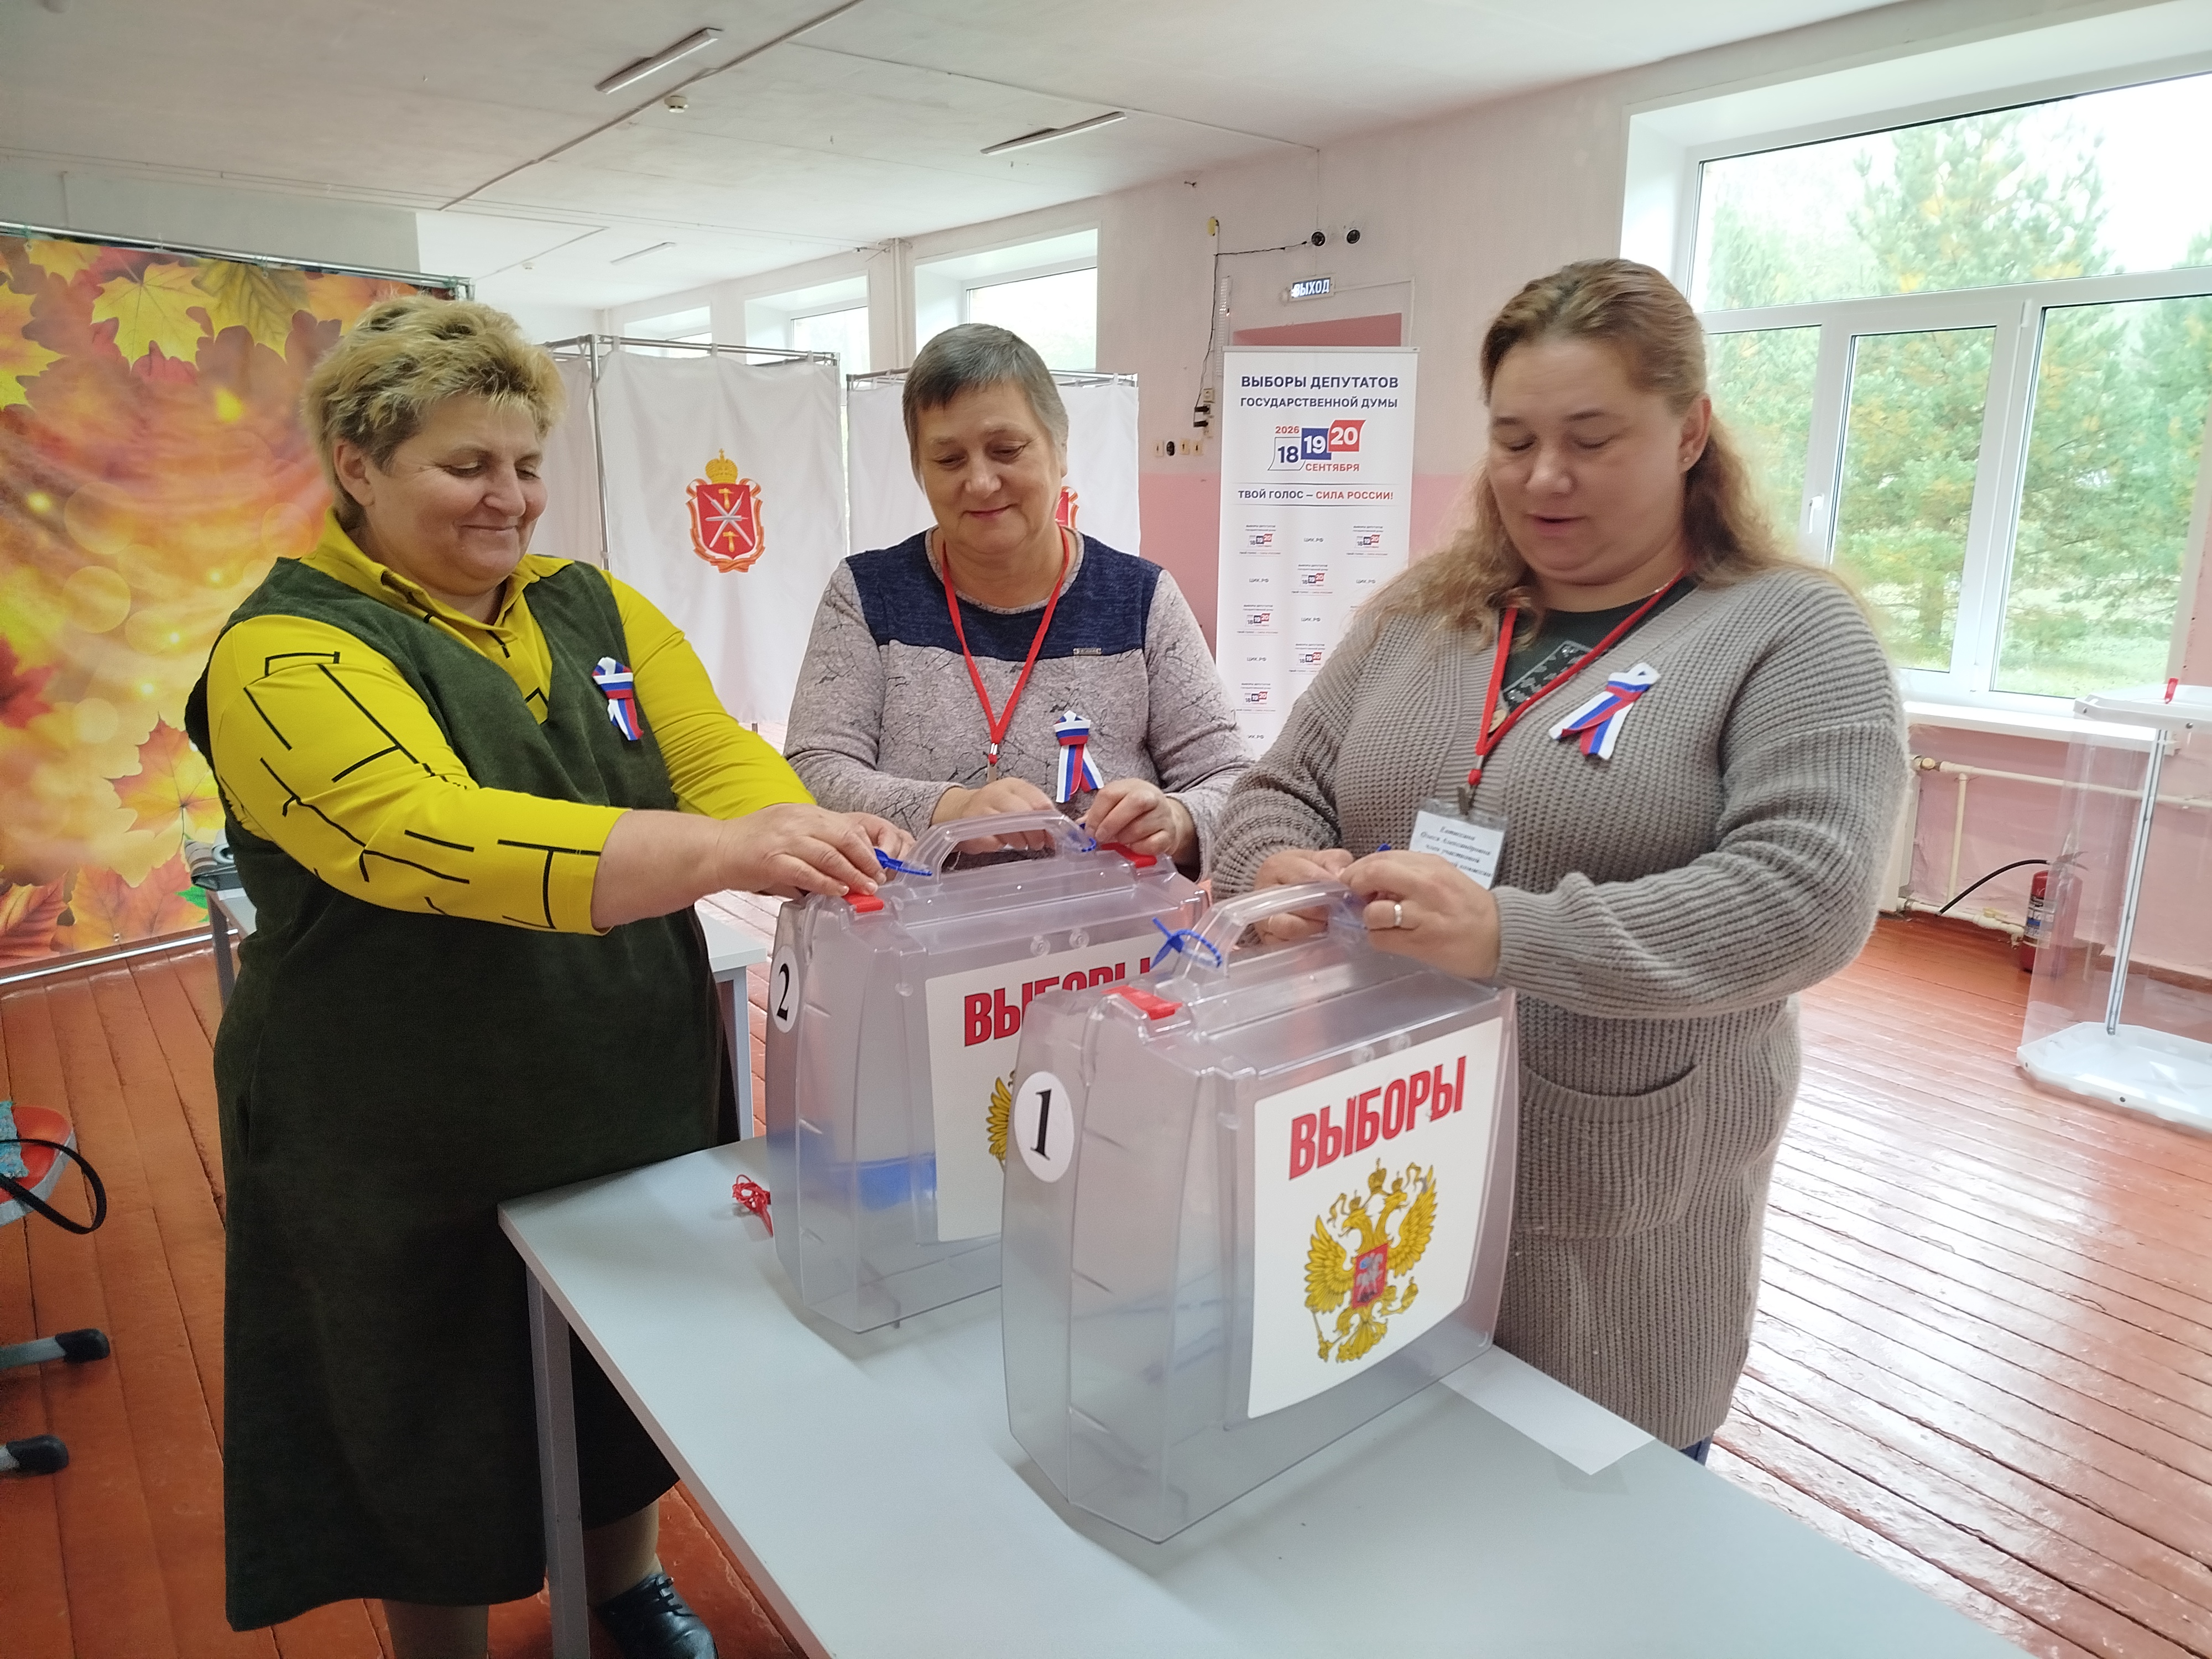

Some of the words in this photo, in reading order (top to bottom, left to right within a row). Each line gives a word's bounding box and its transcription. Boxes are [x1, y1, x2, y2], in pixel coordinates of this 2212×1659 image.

[1291, 279, 1330, 298] ВЫХОД
[1241, 376, 1307, 388] ВЫБОРЫ
[1310, 377, 1399, 389] ДЕПУТАТОВ
[1240, 396, 1358, 408] ГОСУДАРСТВЕННОЙ
[1361, 398, 1397, 409] ДУМЫ
[1275, 426, 1300, 434] 2026
[1277, 446, 1299, 463] 18
[1303, 435, 1327, 453] 19
[1330, 427, 1358, 445] 20
[1305, 463, 1360, 472] СЕНТЯБРЯ
[1238, 489, 1266, 499] ТВОЙ
[1269, 491, 1304, 499] ГОЛОС
[1316, 491, 1344, 499] СИЛА
[1347, 491, 1394, 500] РОССИИ!
[776, 963, 790, 1021] 2
[1030, 1088, 1053, 1161] 1
[1288, 1055, 1467, 1181] ВЫБОРЫ
